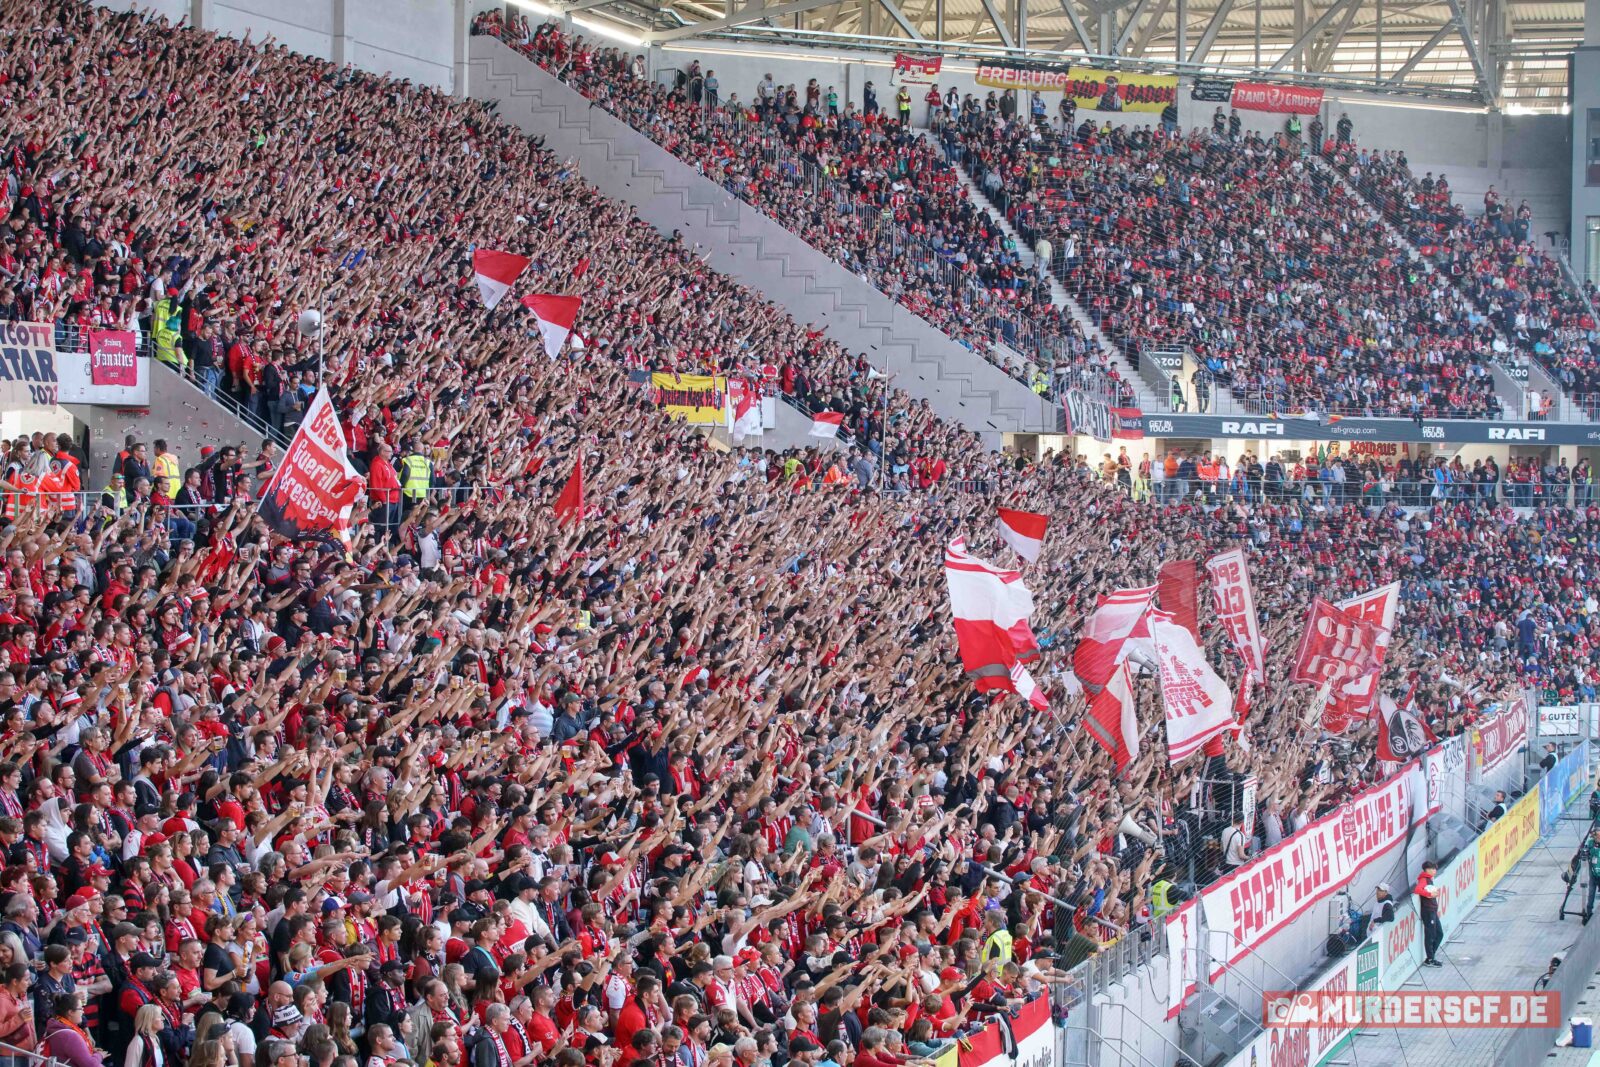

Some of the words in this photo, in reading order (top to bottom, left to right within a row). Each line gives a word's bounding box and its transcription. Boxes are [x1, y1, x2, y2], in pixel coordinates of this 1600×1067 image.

[978, 65, 1067, 87] FREIBURG
[1236, 90, 1265, 103] RAND
[1286, 93, 1319, 107] GRUPPE
[94, 349, 133, 368] Fanatics
[310, 402, 344, 452] Bier
[1222, 422, 1284, 435] RAFI
[1331, 426, 1377, 435] rafi-group.com
[1488, 428, 1545, 440] RAFI
[1548, 713, 1577, 721] GUTEX
[1230, 831, 1330, 949] SPORT-CLUB
[1333, 791, 1394, 875] FREIBURG
[1455, 853, 1475, 898] CAZOO
[1388, 911, 1416, 964] CAZOO
